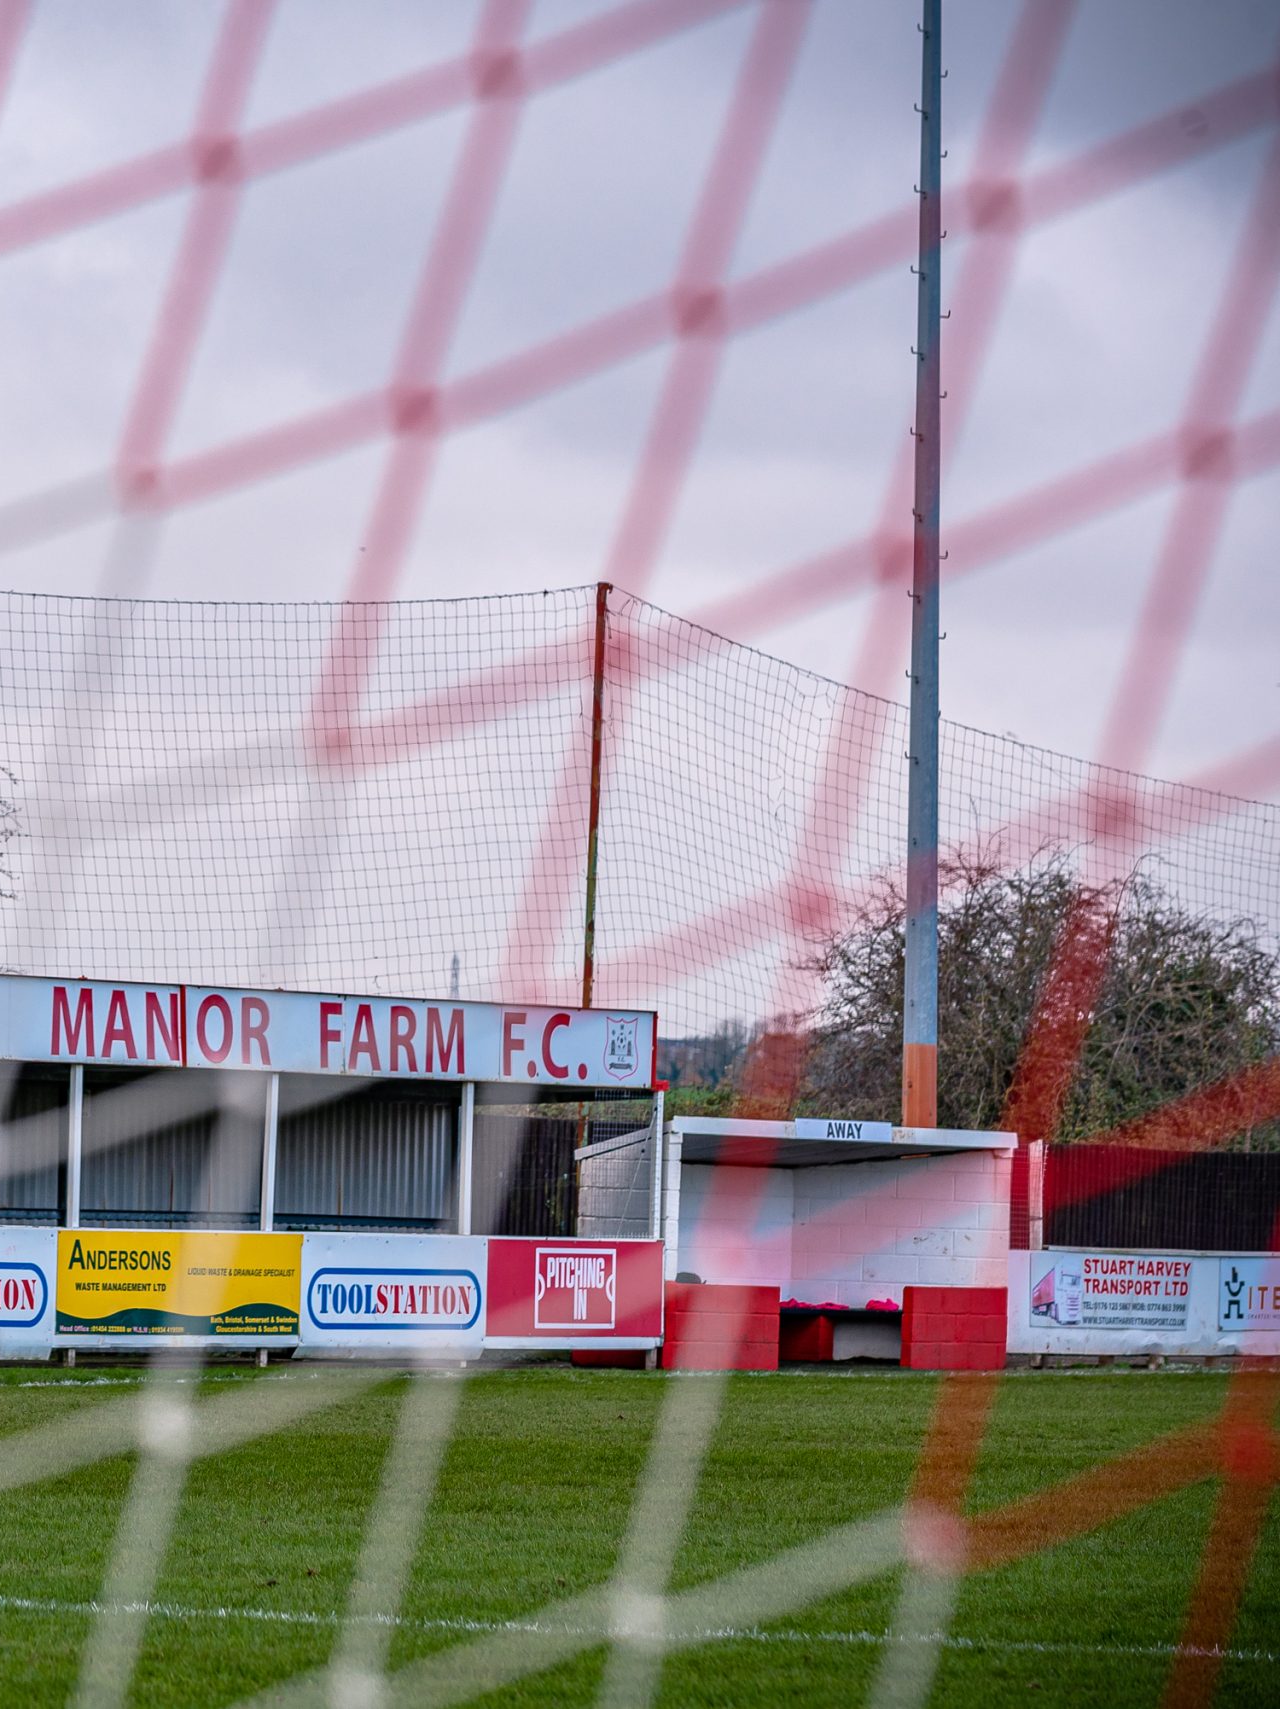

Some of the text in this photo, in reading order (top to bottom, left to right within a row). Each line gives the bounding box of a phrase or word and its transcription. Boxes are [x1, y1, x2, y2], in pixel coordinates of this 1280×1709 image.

[50, 985, 272, 1066] MANOR
[319, 1001, 466, 1074] FARM
[503, 1011, 588, 1080] F.C.
[826, 1121, 863, 1140] AWAY
[546, 1256, 605, 1289] PITCHING
[1083, 1258, 1193, 1278] STUART HARVEY
[75, 1282, 167, 1292] WASTE MANAGEMENT LTD
[317, 1283, 472, 1315] TOOLSTATION
[1083, 1278, 1189, 1297] TRANSPORT LTD
[573, 1288, 587, 1321] IN
